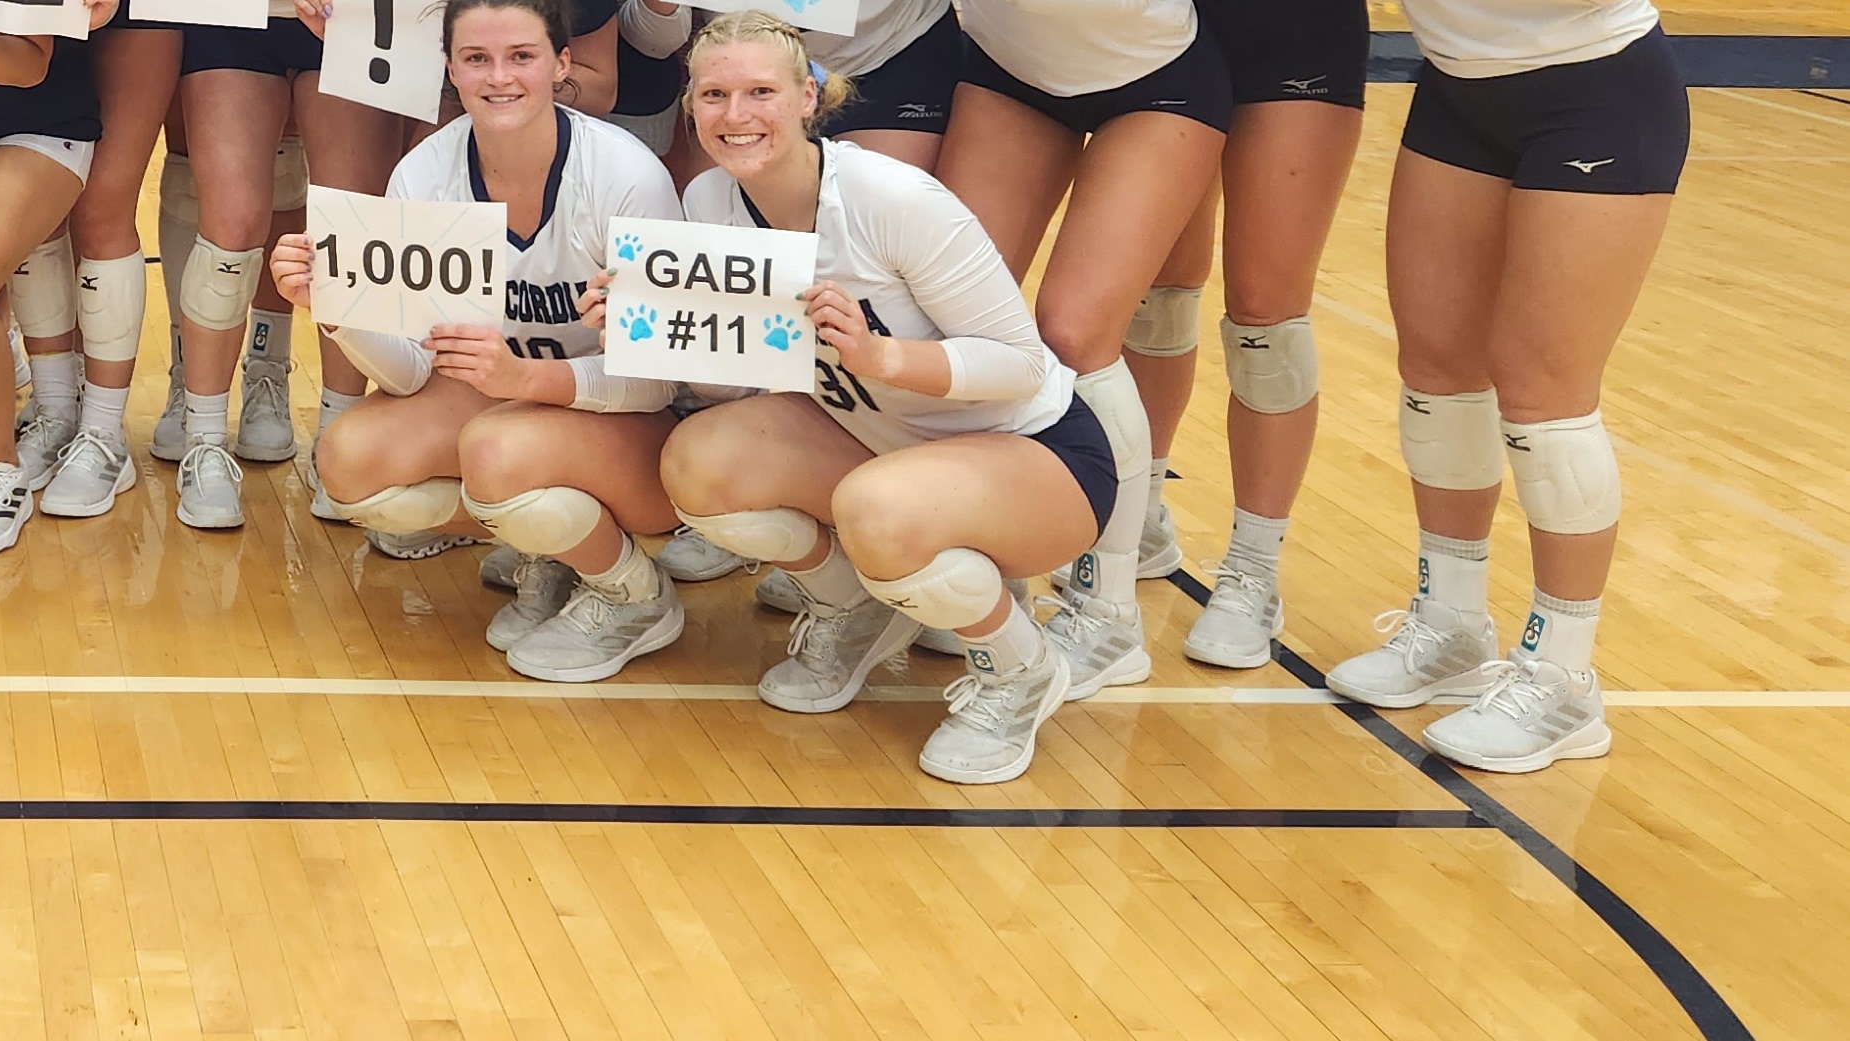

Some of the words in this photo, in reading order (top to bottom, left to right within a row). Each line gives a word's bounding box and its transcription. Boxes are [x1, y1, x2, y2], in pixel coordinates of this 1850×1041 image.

[316, 234, 493, 295] 1,000!
[645, 249, 773, 297] GABI
[668, 310, 745, 354] #11
